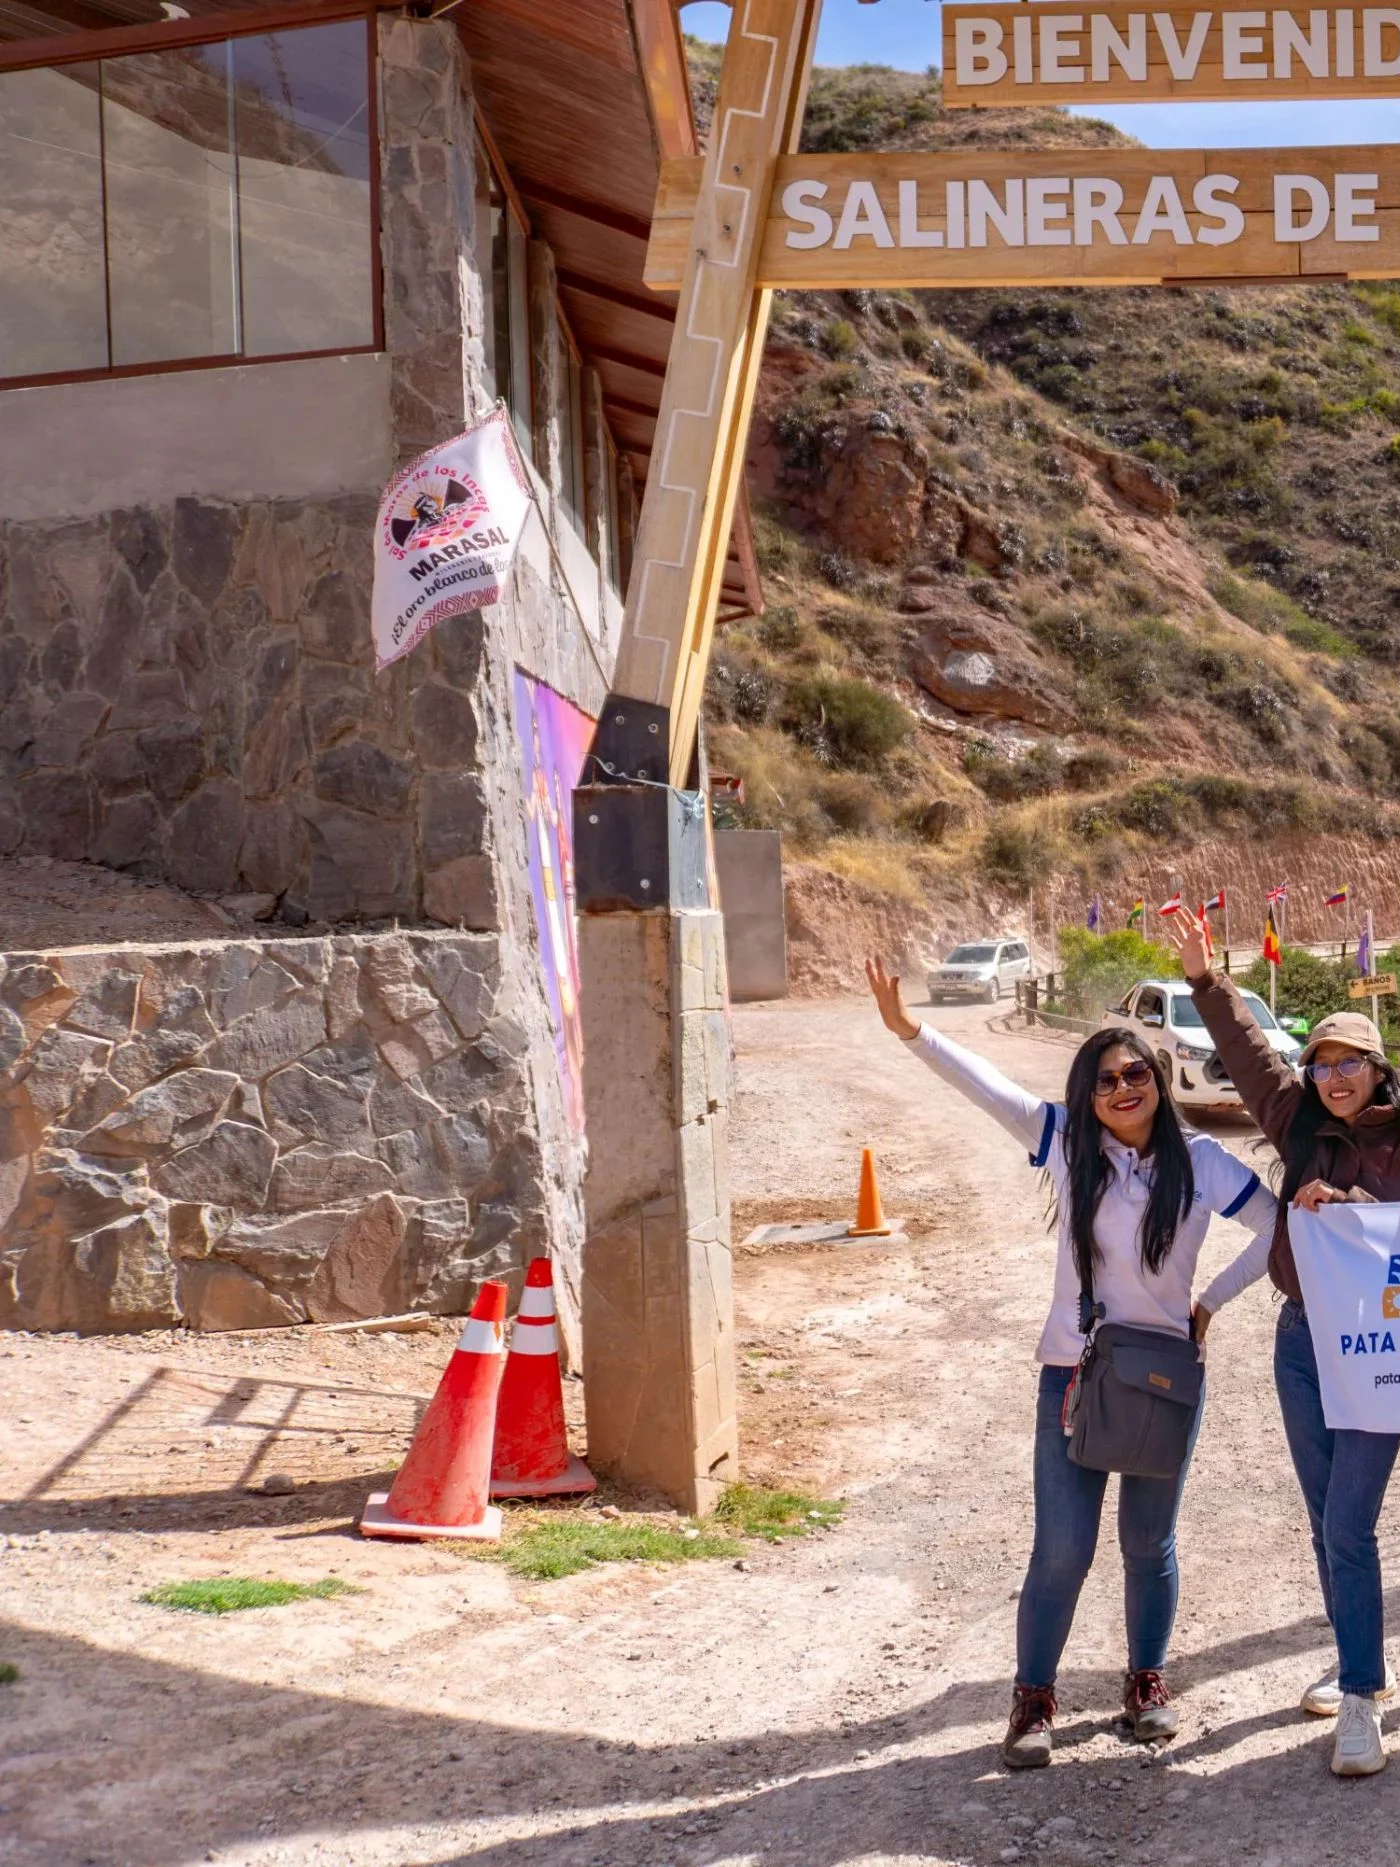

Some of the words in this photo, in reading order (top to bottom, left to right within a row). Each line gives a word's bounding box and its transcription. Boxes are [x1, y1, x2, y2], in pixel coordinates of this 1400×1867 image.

[781, 173, 1245, 250] SALINERAS
[1273, 173, 1379, 243] DE
[412, 470, 429, 482] de
[434, 465, 457, 477] los
[462, 473, 489, 512] Incas
[409, 525, 509, 582] MARASAL
[405, 595, 426, 618] oro
[424, 567, 477, 596] blanco
[479, 560, 494, 576] de
[1340, 1331, 1396, 1355] PATA
